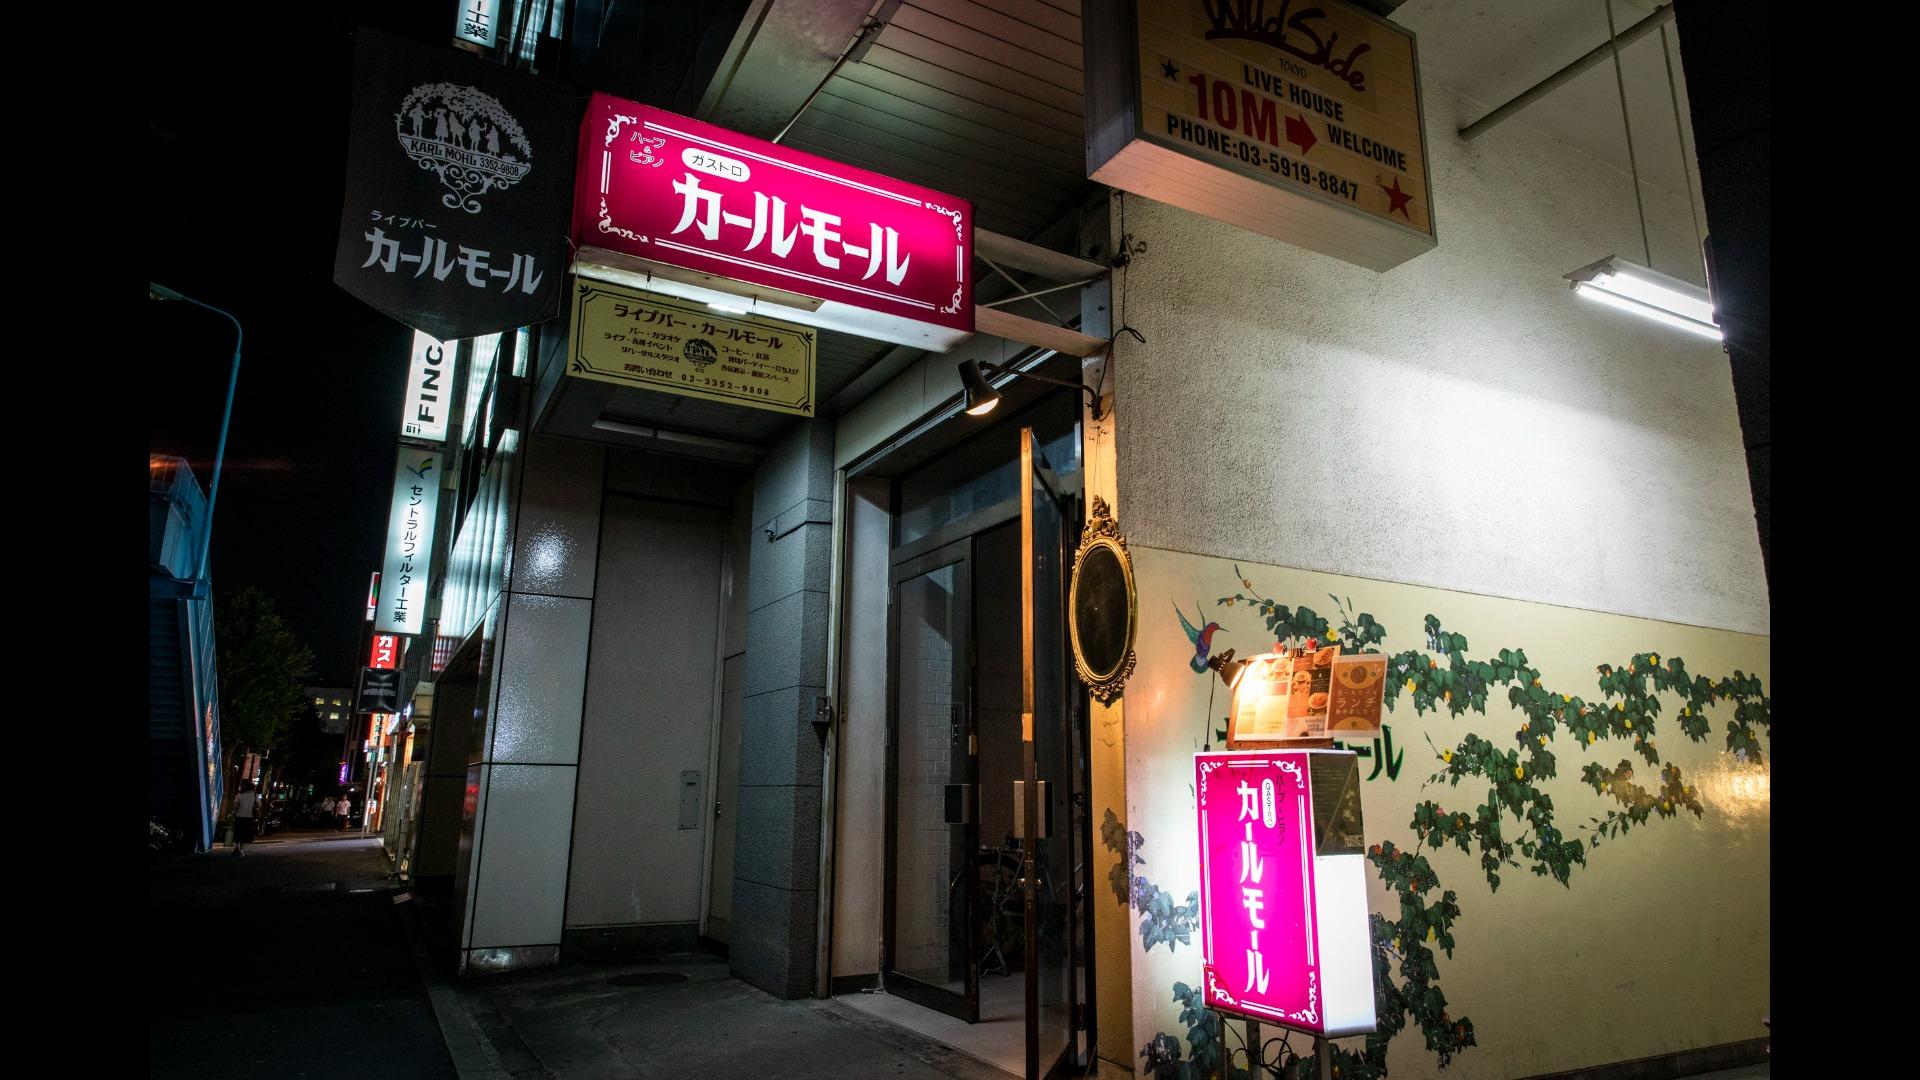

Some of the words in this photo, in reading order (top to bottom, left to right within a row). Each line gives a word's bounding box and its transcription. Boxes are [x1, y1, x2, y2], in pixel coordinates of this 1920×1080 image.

[1279, 57, 1308, 79] TOKYO
[1287, 8, 1371, 92] Side
[1188, 72, 1279, 148] 10M
[1243, 64, 1285, 99] LIVE
[1289, 84, 1344, 123] HOUSE
[410, 139, 442, 156] KARL
[445, 148, 477, 166] MOHL
[479, 156, 519, 177] 3352-9808
[629, 150, 665, 168] ピアノ
[630, 131, 666, 149] ハープ
[1327, 123, 1408, 172] WELCOME
[691, 154, 743, 178] ガストロ
[370, 209, 437, 229] ライブバー
[670, 171, 911, 287] カールモール
[360, 226, 544, 295] カールモール
[418, 343, 445, 424] FINC
[393, 484, 424, 624] セントラルフィルター工業
[1338, 697, 1377, 708] ランチ
[1265, 782, 1274, 827] GASTRO
[1236, 779, 1271, 996] カールモール
